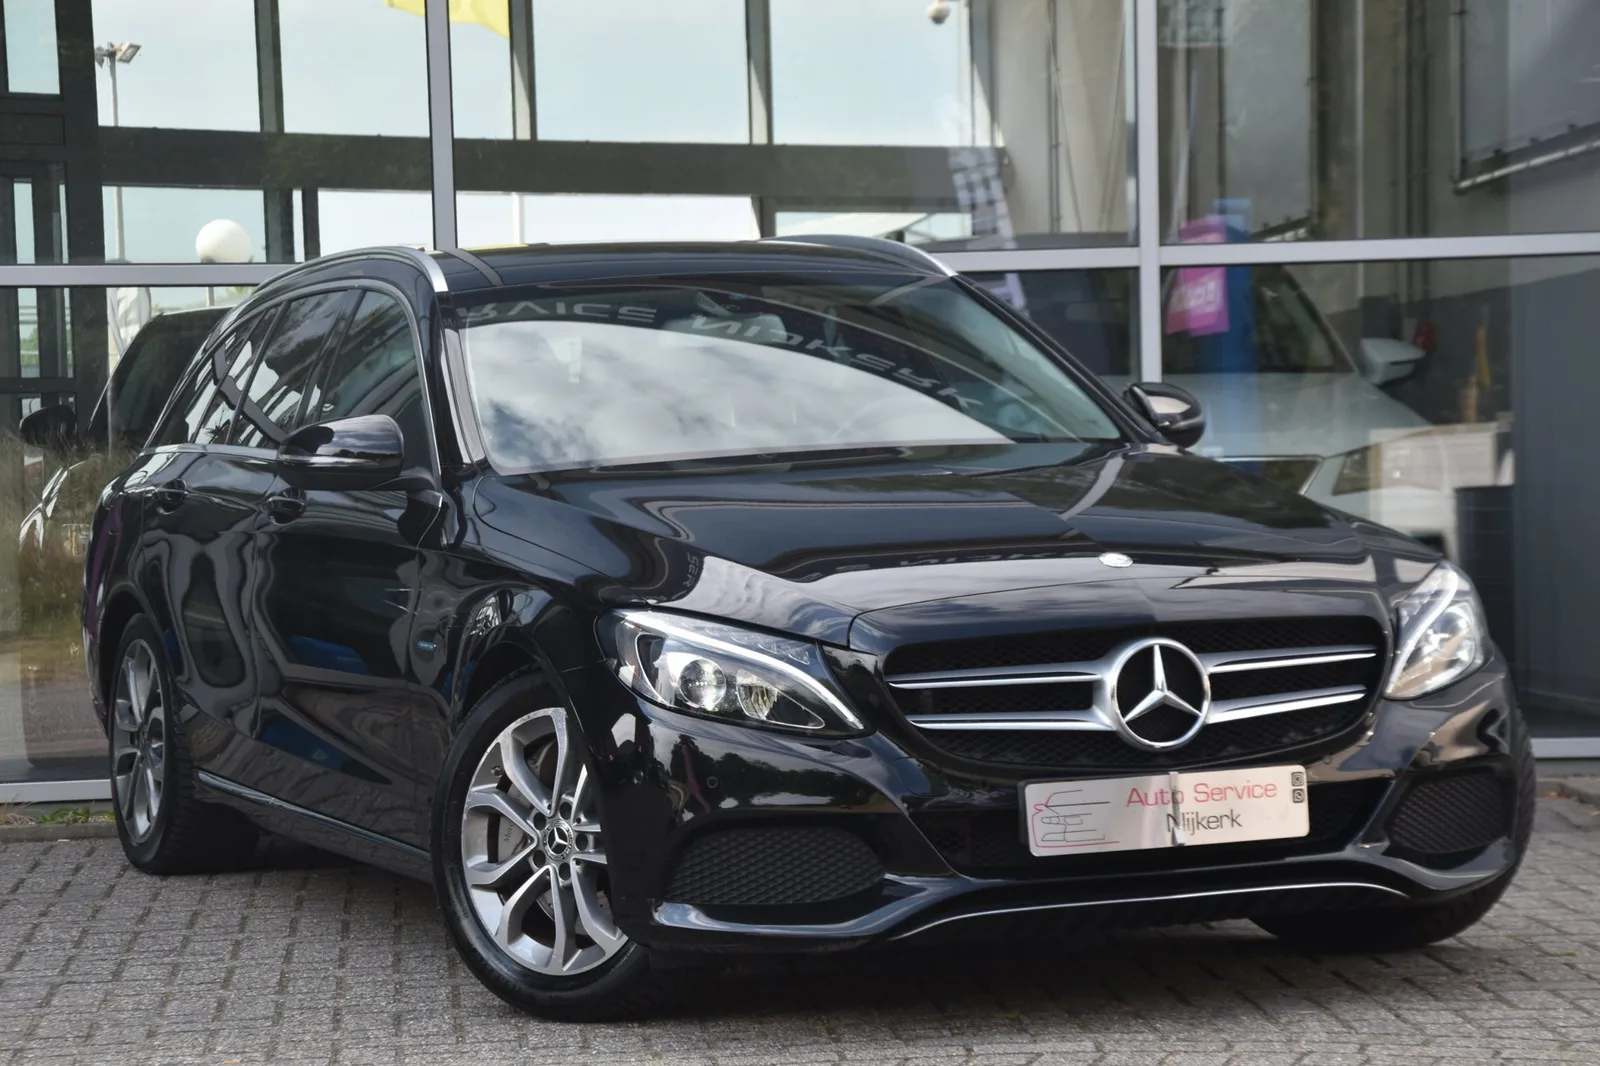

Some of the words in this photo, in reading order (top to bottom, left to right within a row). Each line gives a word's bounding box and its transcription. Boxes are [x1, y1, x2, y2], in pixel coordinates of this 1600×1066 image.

[1126, 787, 1185, 807] Auto
[1193, 780, 1278, 803] Service
[1166, 809, 1243, 836] Nijkerk
